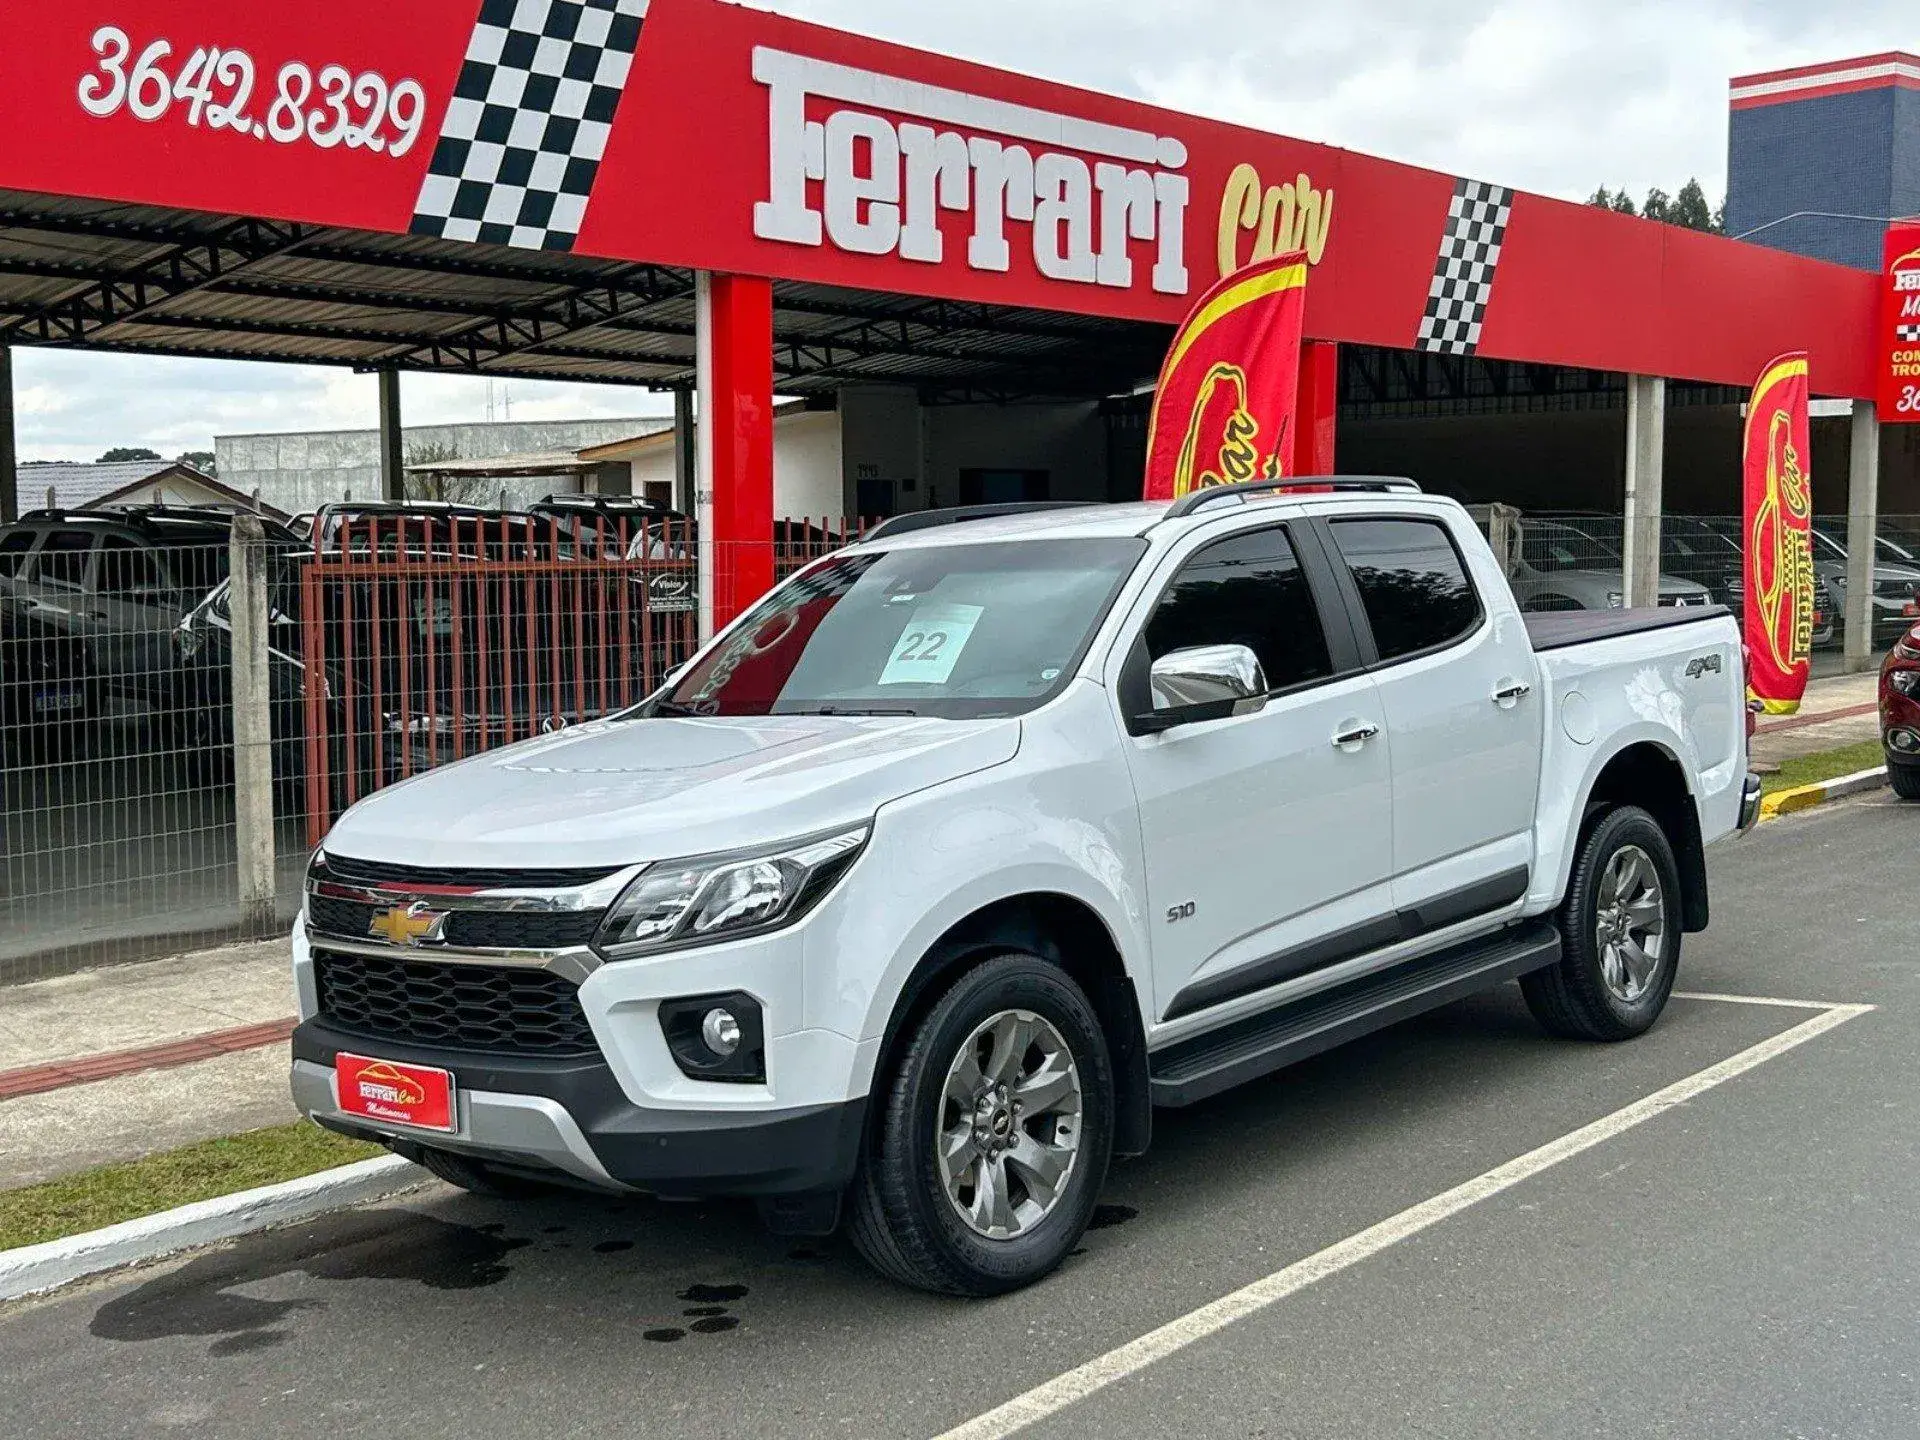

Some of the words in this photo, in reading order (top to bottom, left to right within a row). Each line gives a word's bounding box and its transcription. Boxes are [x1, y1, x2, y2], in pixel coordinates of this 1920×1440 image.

[78, 26, 425, 158] 3642.8329
[752, 45, 1189, 295] Ferrari
[1781, 443, 1810, 518] Car
[1788, 529, 1813, 664] Ferrari
[898, 632, 948, 661] 22
[1166, 901, 1195, 924] S10
[359, 1081, 399, 1103] Ferrari
